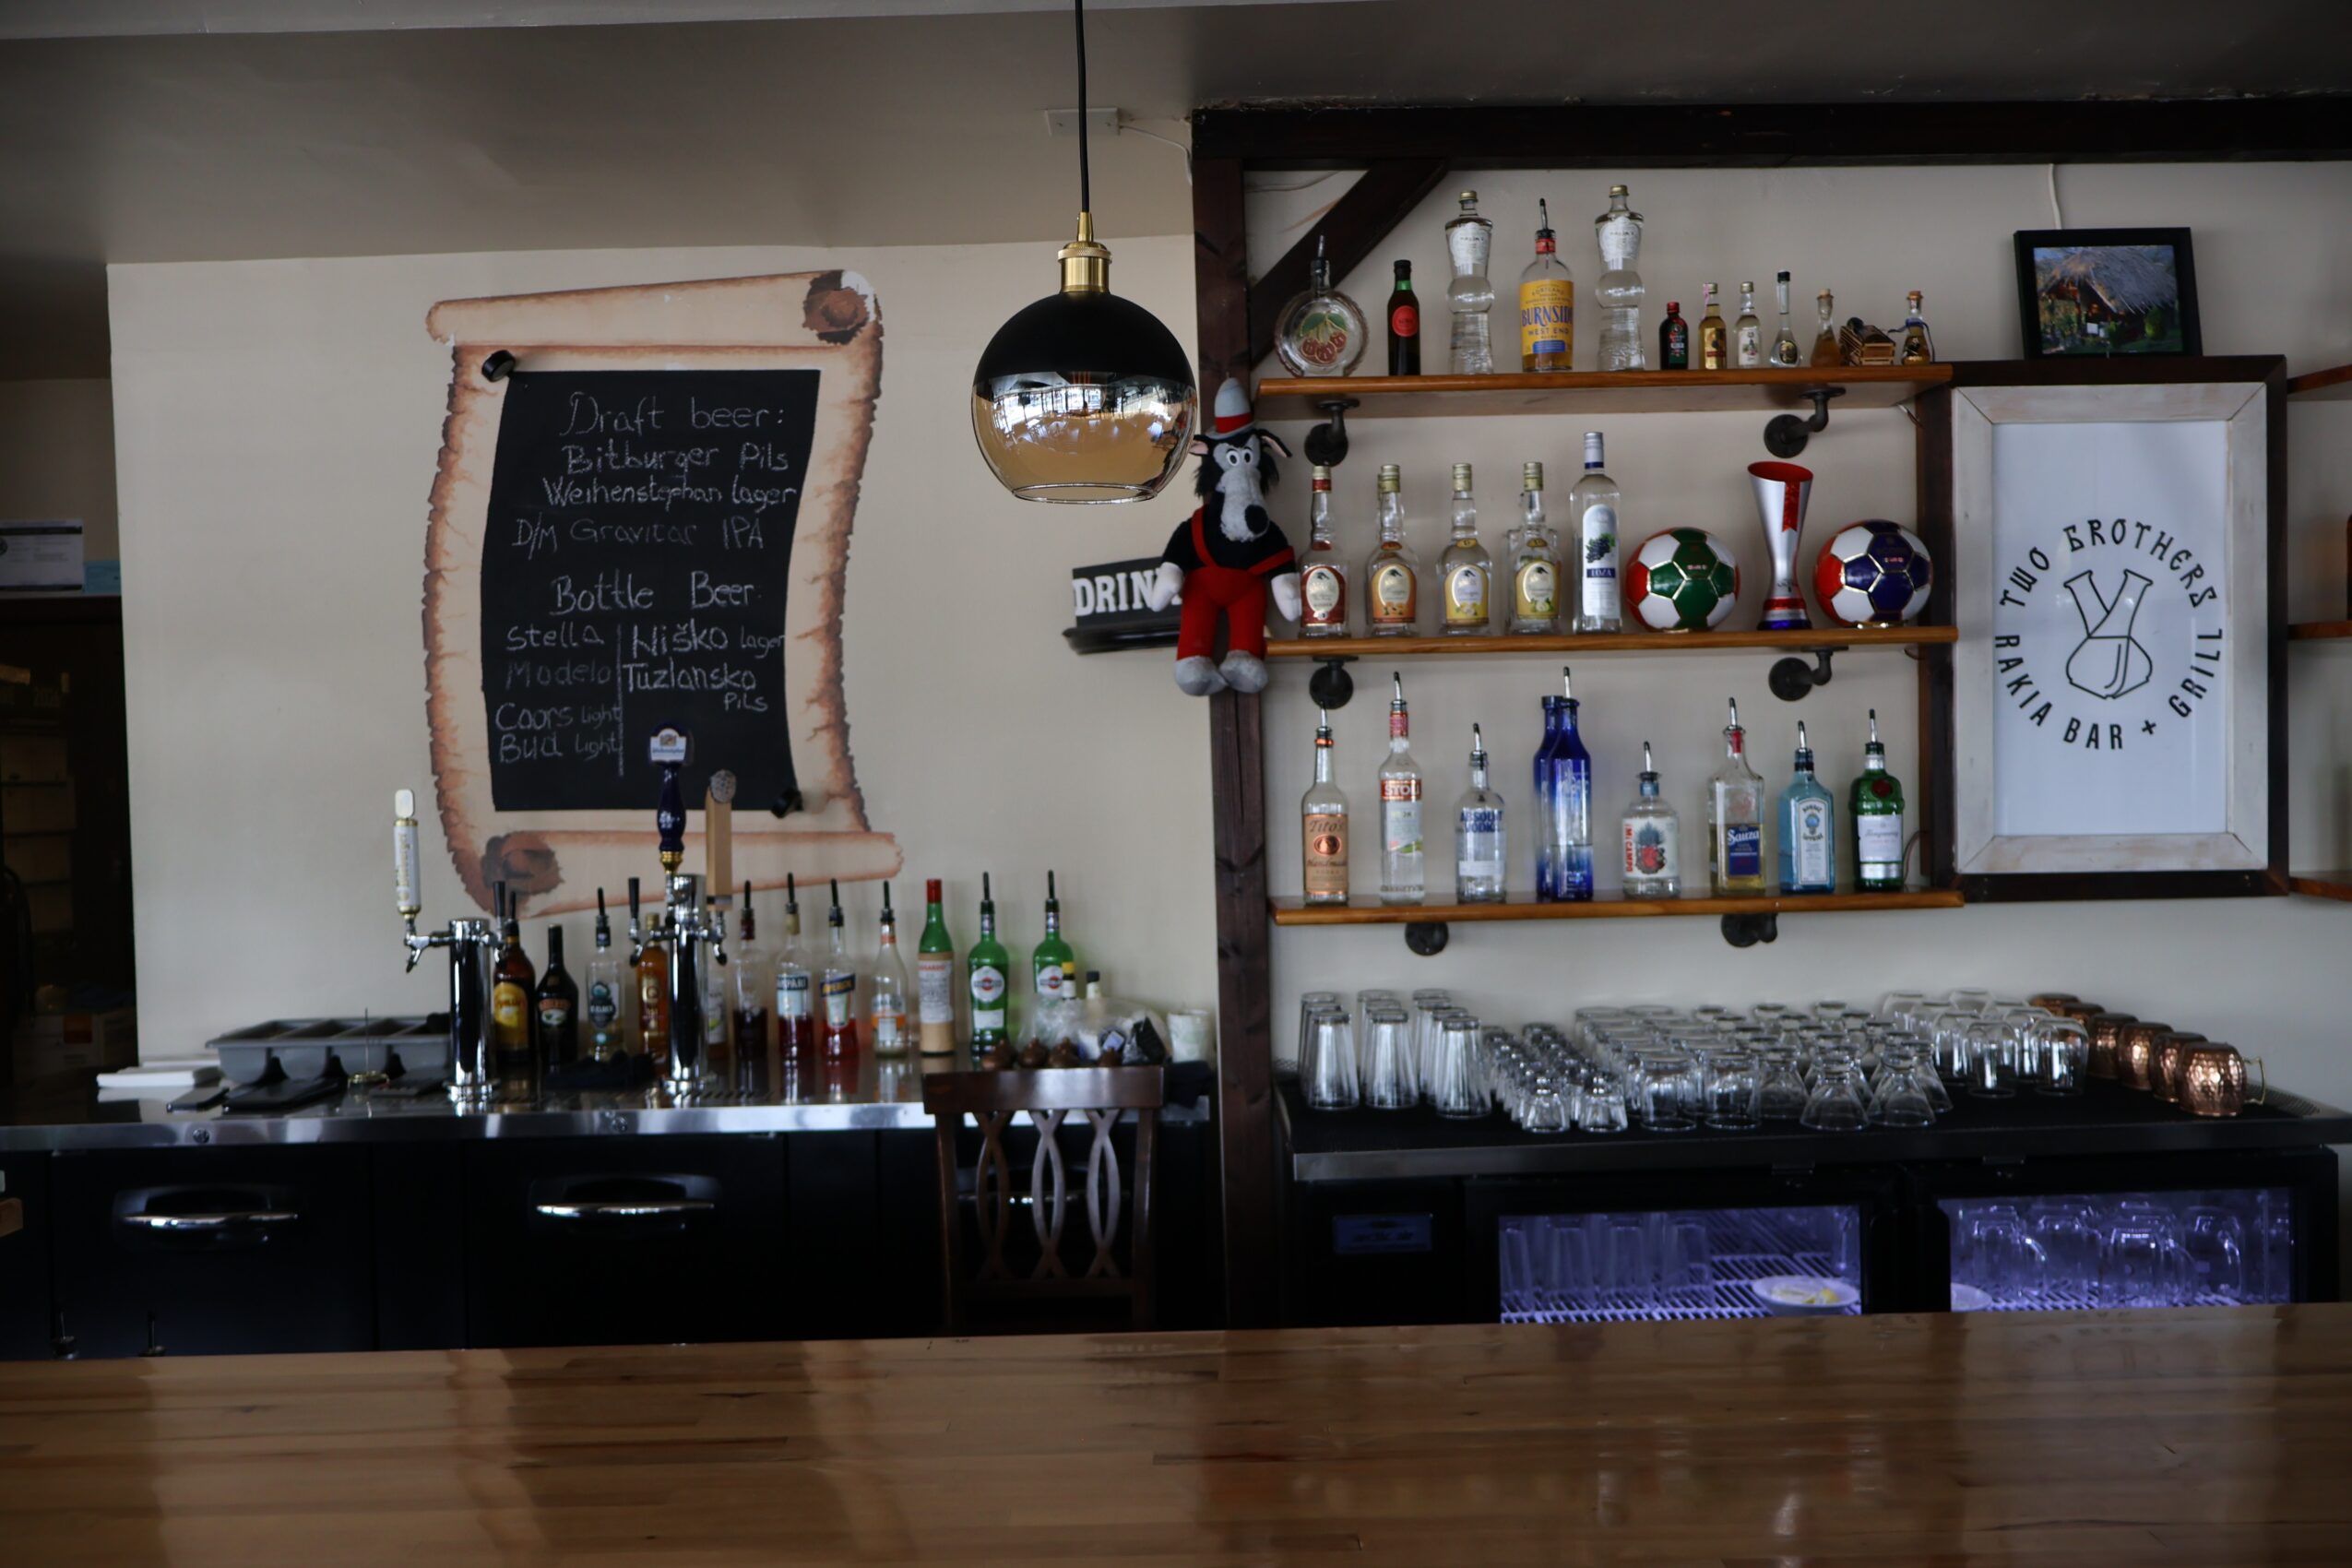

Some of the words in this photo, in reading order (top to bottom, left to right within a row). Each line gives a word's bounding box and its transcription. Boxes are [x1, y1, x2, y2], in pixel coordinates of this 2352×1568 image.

[1521, 305, 1574, 327] BURNSID
[559, 391, 665, 436] Draft
[691, 396, 784, 429] beer:
[561, 438, 719, 480] Bitburger
[740, 442, 789, 471] Pils
[542, 475, 722, 512] Weihenstephan
[722, 516, 764, 550] IPA
[549, 567, 654, 616] Bottle
[1072, 567, 1182, 617] DRIN
[1999, 546, 2049, 607] TWO
[505, 621, 605, 651] Stella
[505, 659, 612, 690] Modelo
[1994, 635, 2053, 727] RAKIA
[2062, 717, 2123, 750] BAR
[2168, 628, 2223, 718] GRILL
[494, 701, 573, 730] Coors
[498, 733, 564, 764] Bud
[1385, 784, 1420, 796] STOI
